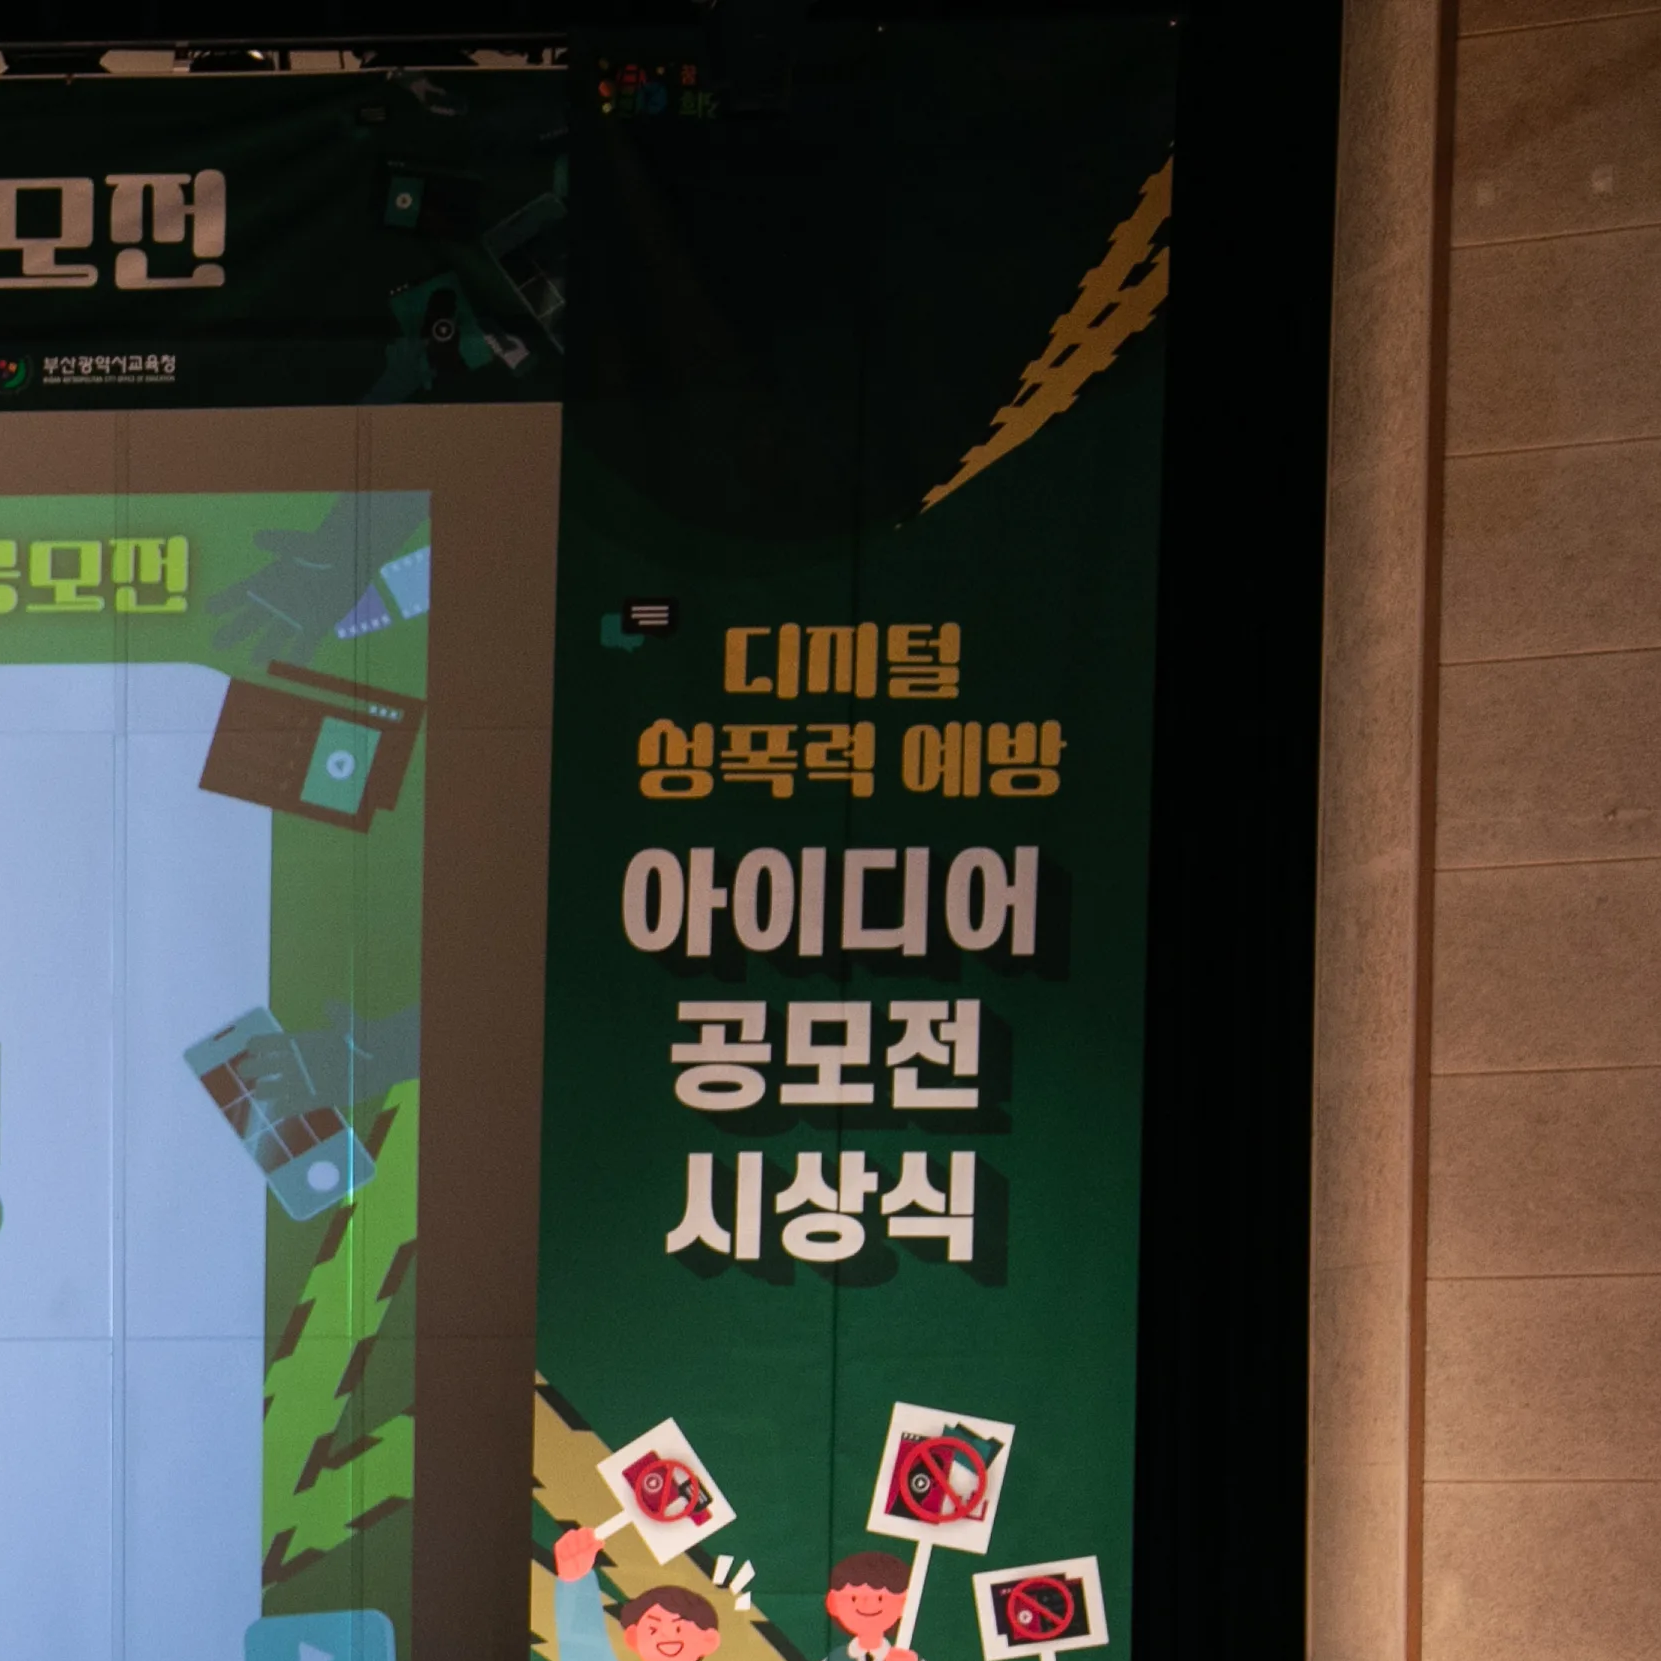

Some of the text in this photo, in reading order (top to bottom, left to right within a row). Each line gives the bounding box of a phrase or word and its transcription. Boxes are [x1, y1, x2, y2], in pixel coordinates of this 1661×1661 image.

[42, 354, 177, 375] 부산광역시교육청
[723, 622, 961, 700] 디지털
[637, 718, 1068, 800] 성폭력 예방
[621, 845, 1040, 958] 아이디어
[670, 998, 981, 1112] 공모전
[665, 1150, 977, 1263] 시상식
